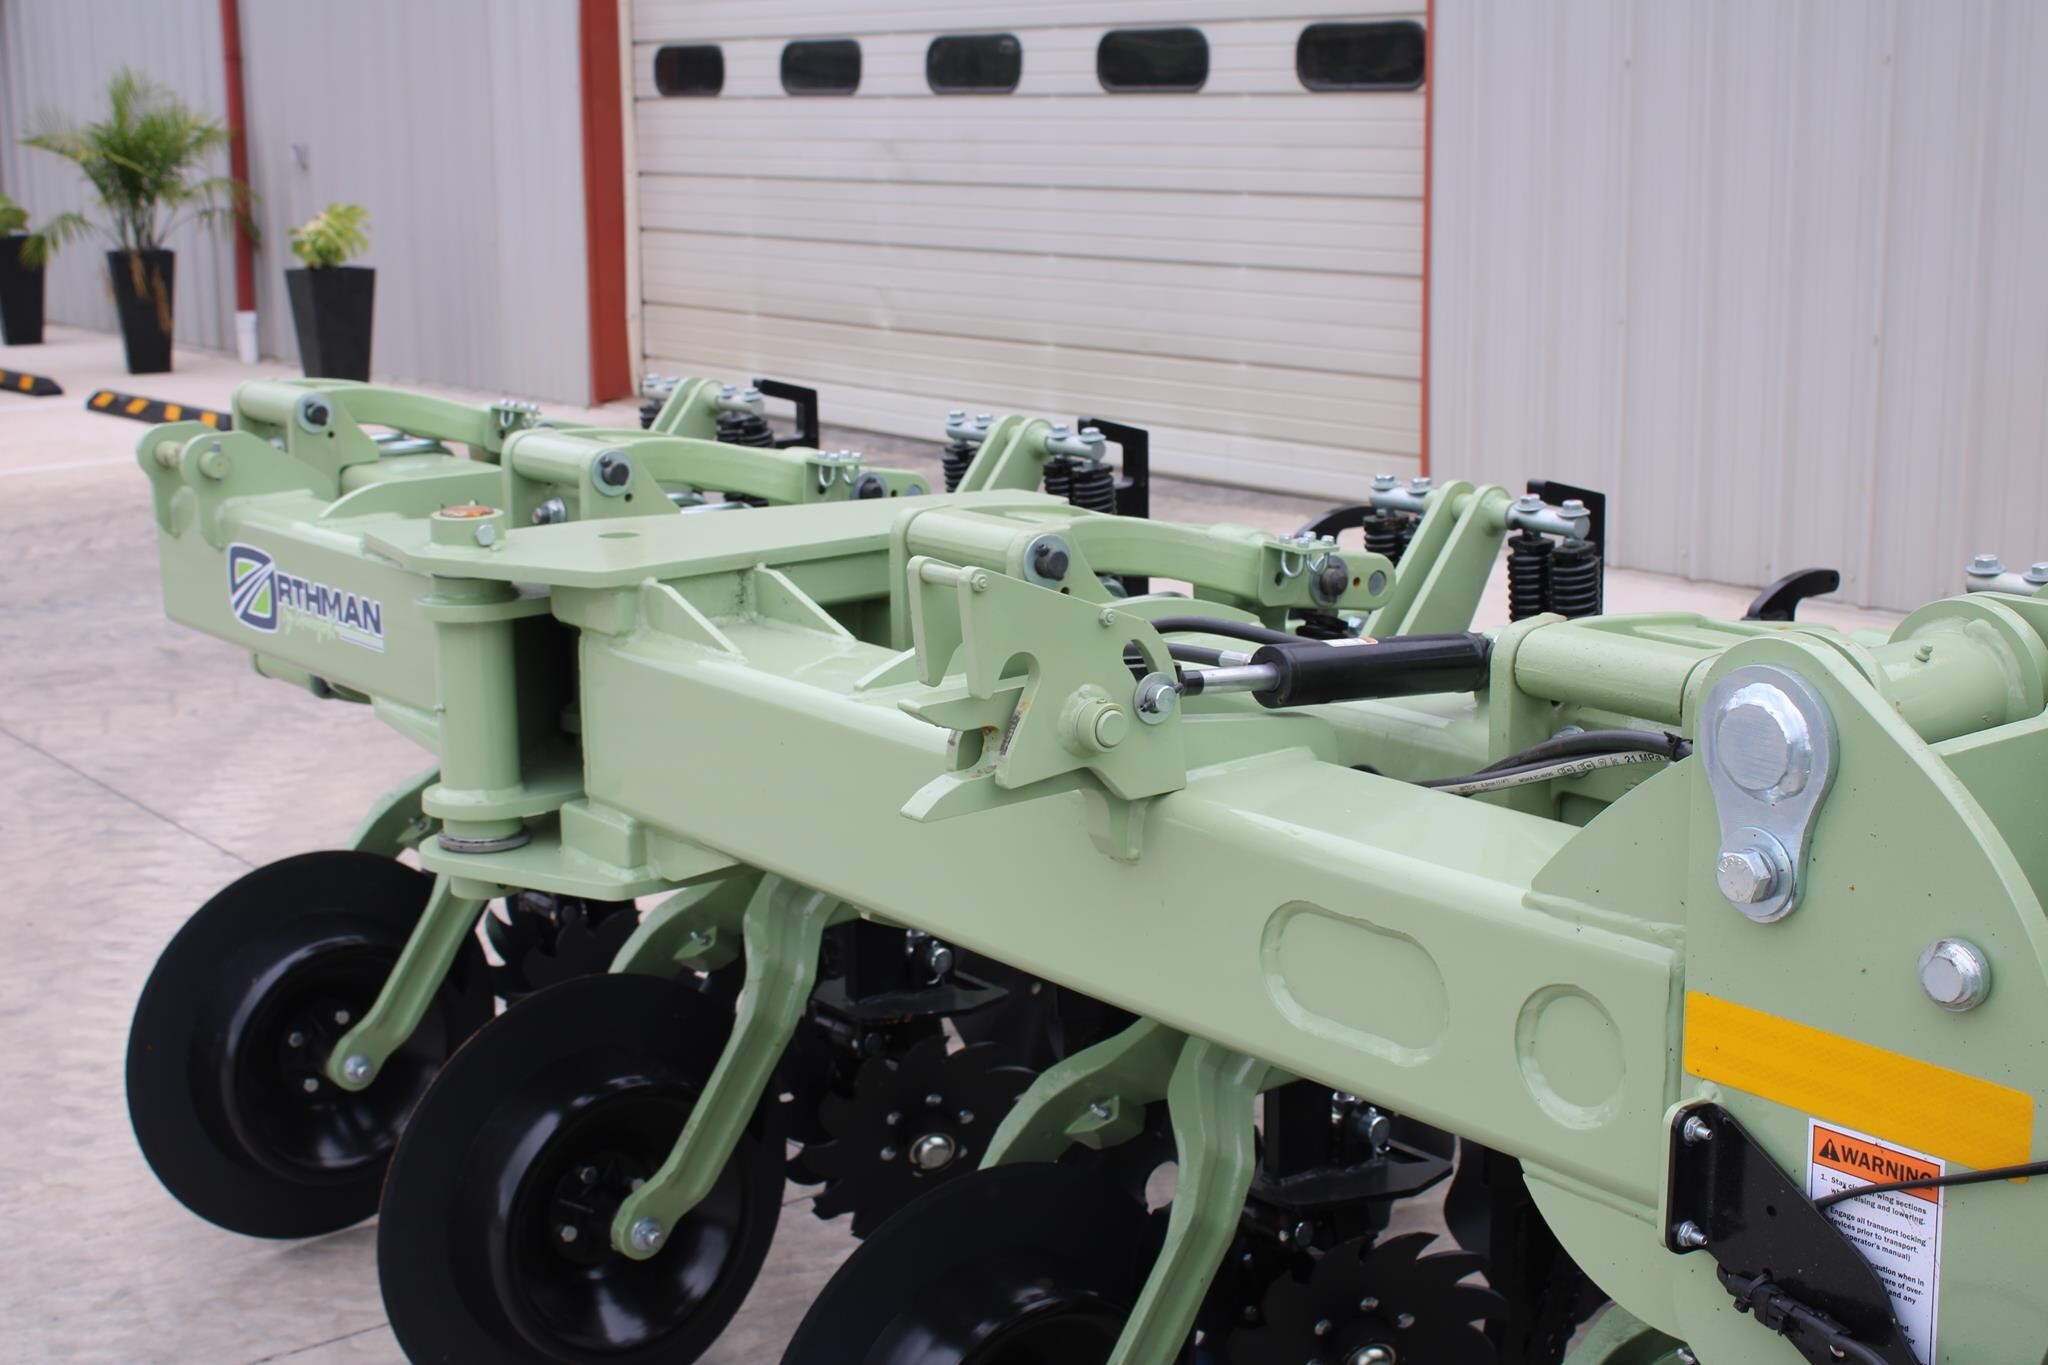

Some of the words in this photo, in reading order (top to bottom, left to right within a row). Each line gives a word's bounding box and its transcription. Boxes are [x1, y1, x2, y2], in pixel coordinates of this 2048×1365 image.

[1877, 1192, 1894, 1204] wing
[1895, 1198, 1927, 1214] sections
[1877, 1204, 1891, 1212] and
[1892, 1207, 1925, 1225] lowering.
[1830, 1206, 1855, 1220] Engage
[1856, 1217, 1865, 1225] all
[1867, 1219, 1899, 1237] transport
[1900, 1230, 1926, 1247] locking
[1857, 1227, 1873, 1237] prior
[1875, 1233, 1882, 1241] to
[1884, 1236, 1919, 1254] transport.
[1882, 1247, 1911, 1262] manual)
[1898, 1272, 1916, 1284] when
[1917, 1278, 1924, 1287] in
[1888, 1289, 1901, 1299] and
[1903, 1295, 1916, 1305] any
[1906, 1286, 1924, 1295] over-
